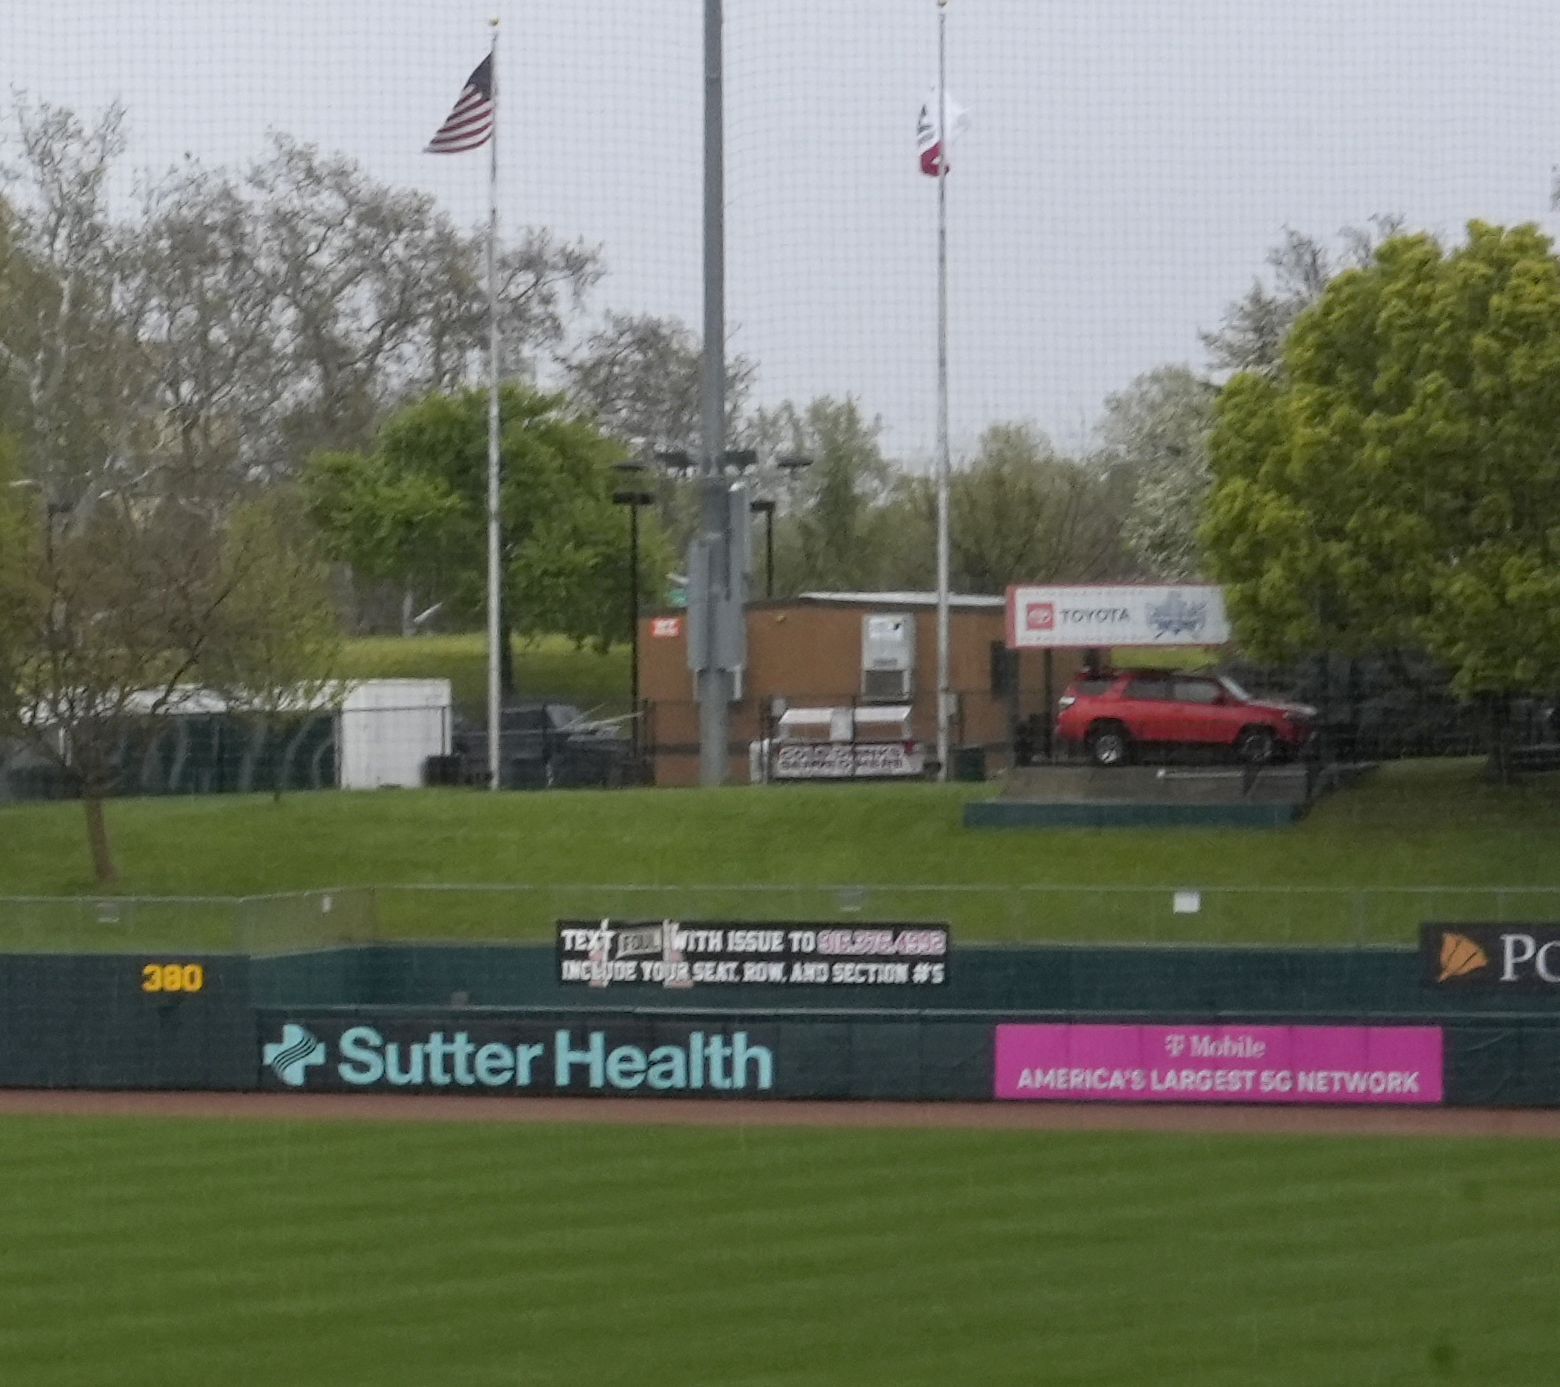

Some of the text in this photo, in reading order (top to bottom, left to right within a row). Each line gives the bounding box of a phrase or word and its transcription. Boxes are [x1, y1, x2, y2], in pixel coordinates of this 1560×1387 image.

[1061, 608, 1130, 624] TOYOTA
[561, 928, 616, 951] TEXT
[671, 929, 723, 952] WITH
[726, 930, 785, 952] ISSUE
[788, 931, 816, 953] TO
[142, 964, 204, 991] 380
[561, 961, 638, 981] INCLUDE
[640, 961, 690, 982] YOUR
[789, 962, 829, 983] AND
[832, 962, 909, 984] SECTION
[337, 1025, 773, 1091] Sutter Health
[1190, 1034, 1266, 1058] Mobile
[1017, 1068, 1420, 1094] AMERICA'S LARGEST 5G NETWORK
